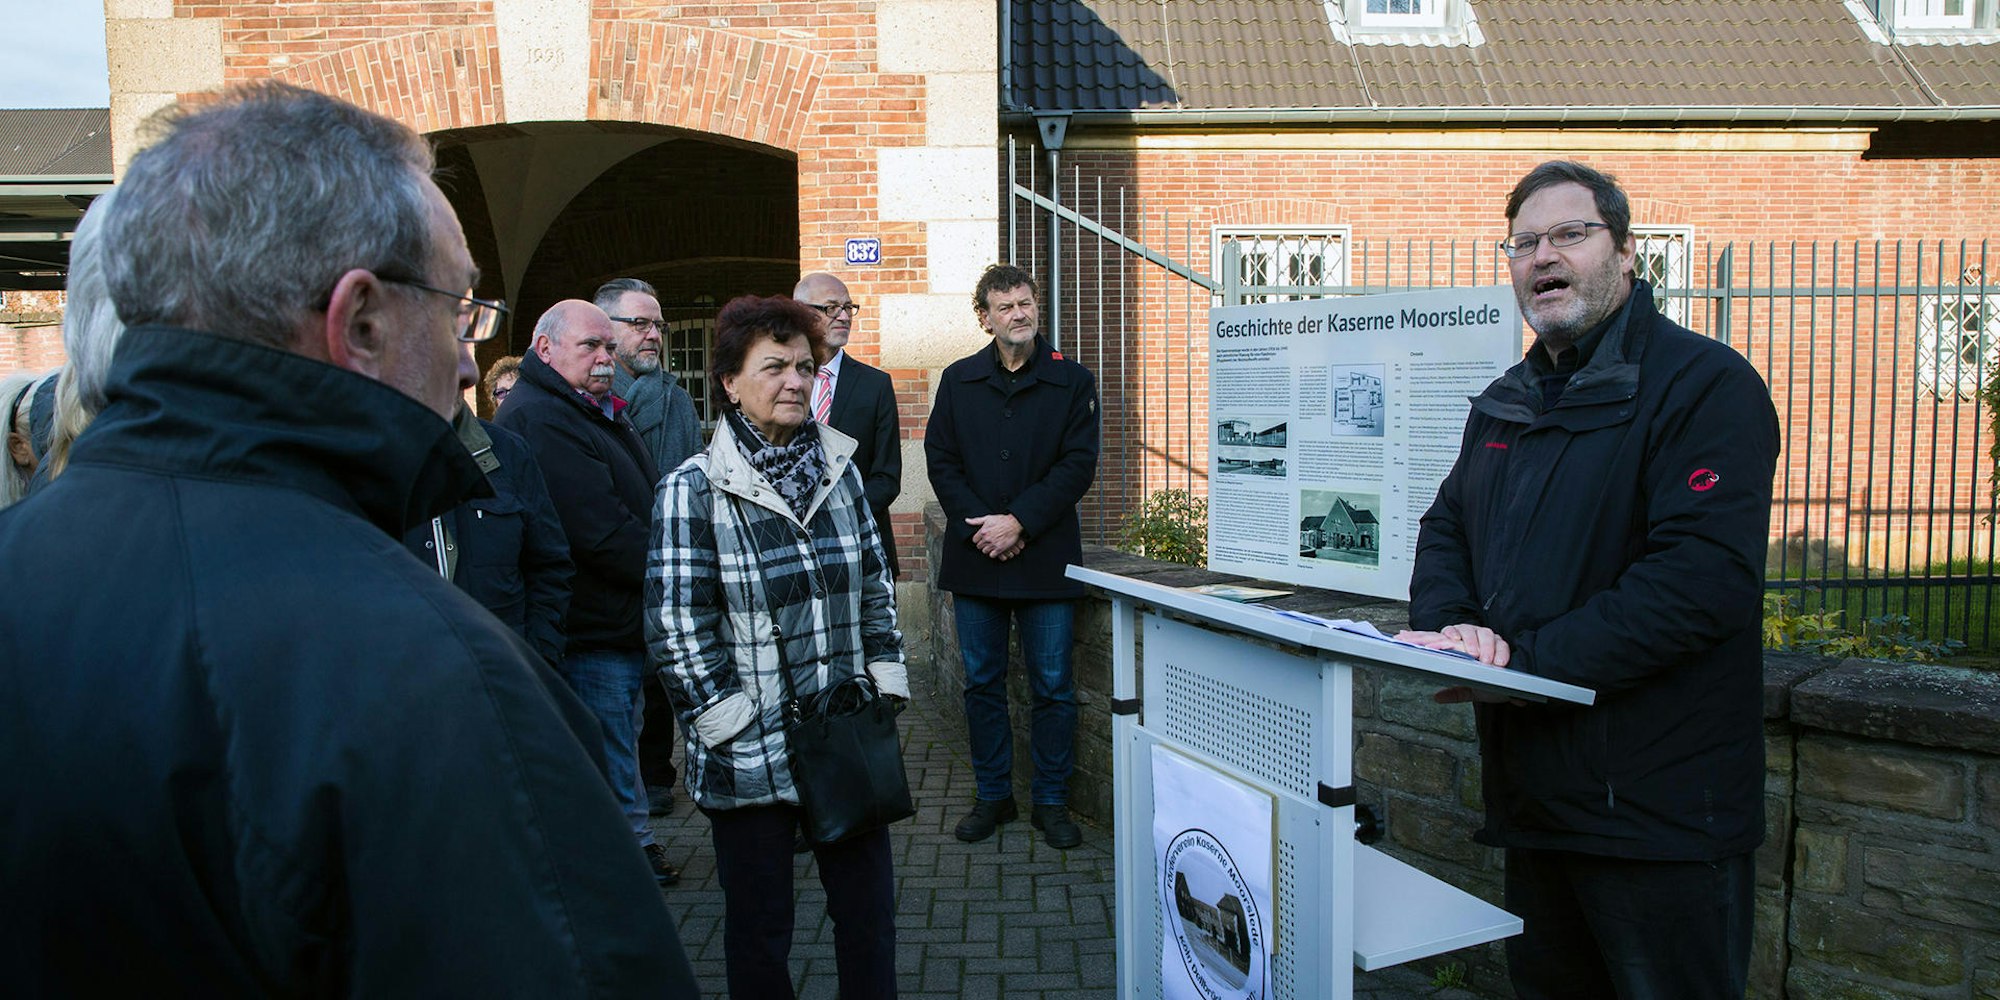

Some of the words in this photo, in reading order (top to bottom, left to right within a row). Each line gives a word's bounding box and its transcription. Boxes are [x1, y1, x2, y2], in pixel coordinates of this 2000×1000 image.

[848, 242, 878, 261] 837
[1216, 317, 1293, 338] Geschichte
[1297, 315, 1323, 334] der
[1327, 313, 1394, 332] Kaserne
[1400, 304, 1500, 329] Moorslede
[1167, 836, 1195, 890] Förderverein
[1196, 836, 1228, 867] Kaserne
[1227, 868, 1259, 947] Moorslede
[1179, 935, 1194, 967] Köln
